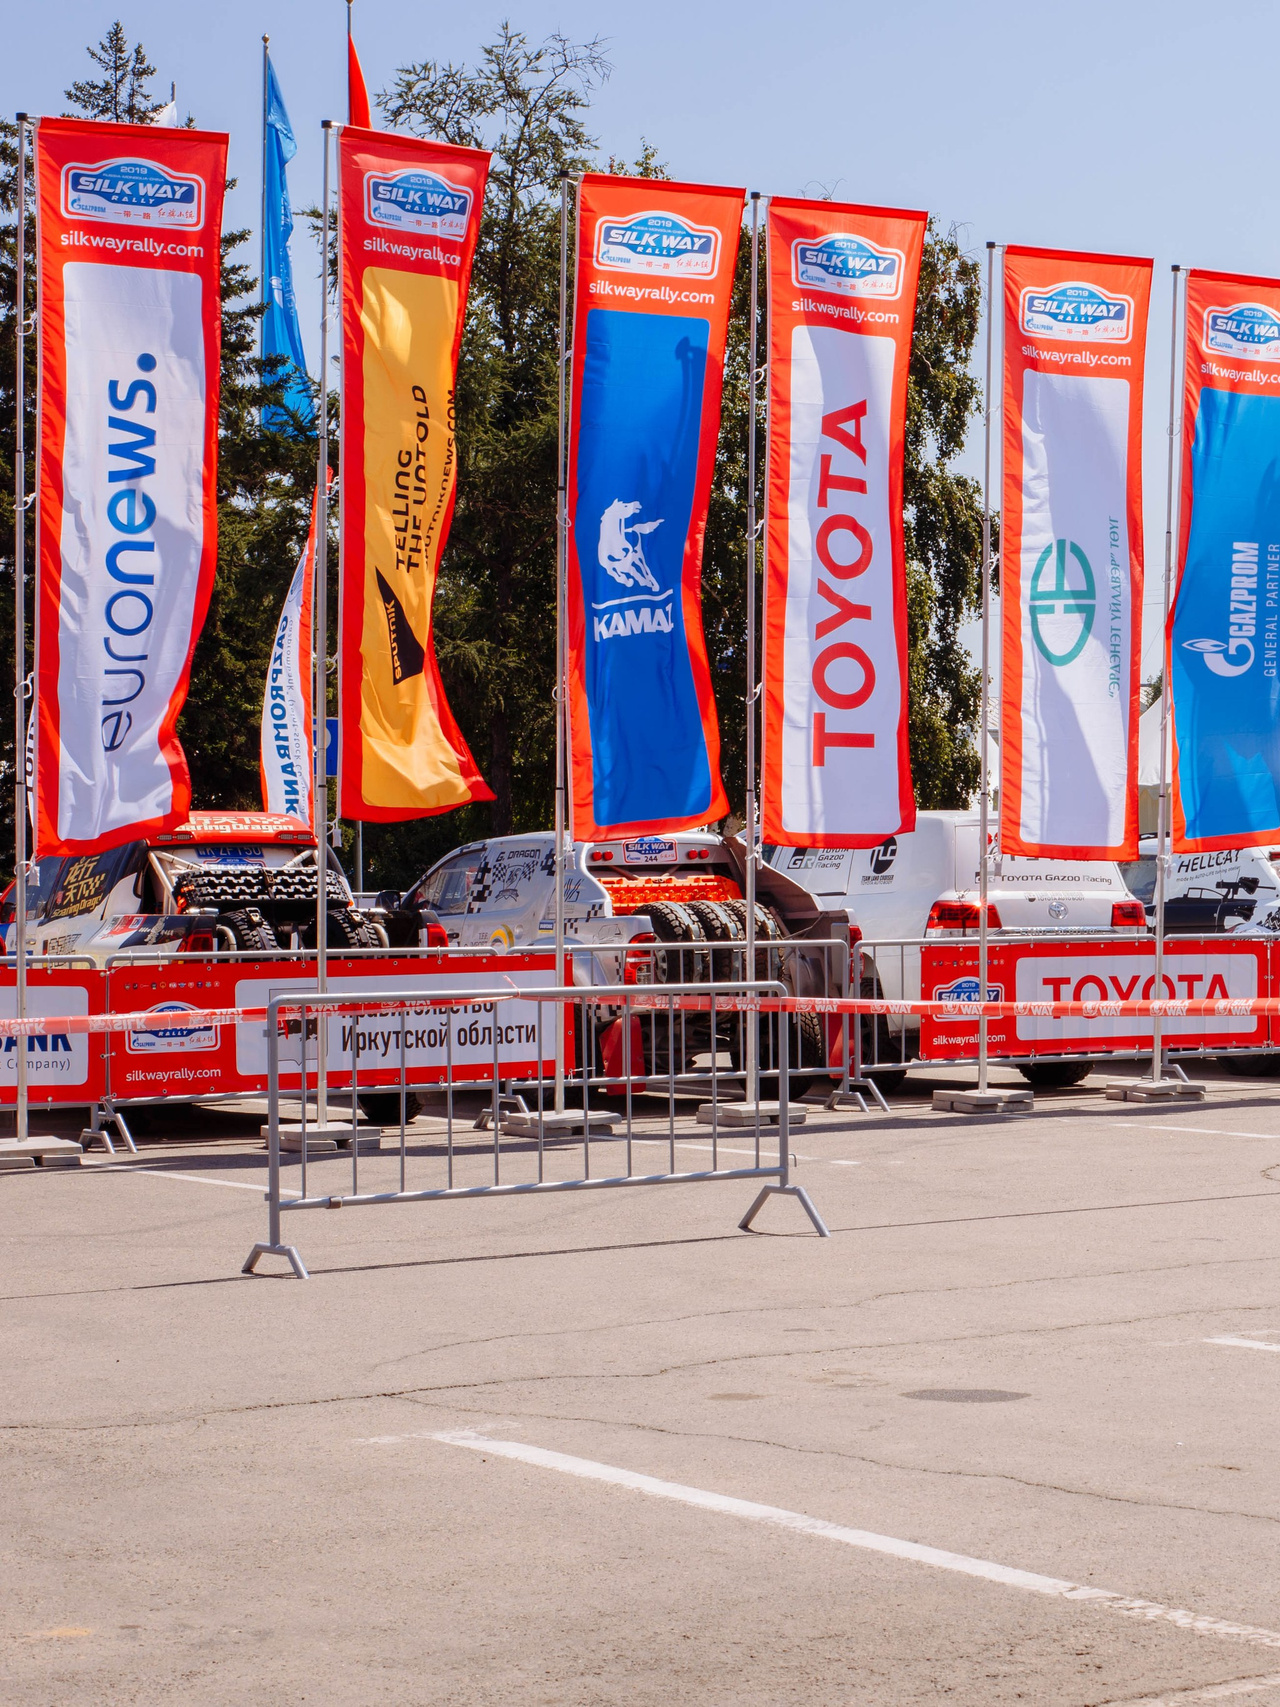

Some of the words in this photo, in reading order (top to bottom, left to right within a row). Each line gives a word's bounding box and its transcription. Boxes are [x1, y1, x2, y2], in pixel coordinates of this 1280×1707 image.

[120, 166, 147, 174] 2019
[410, 176, 433, 185] 2019
[77, 176, 135, 195] SILK
[138, 183, 189, 199] WAY
[377, 186, 423, 204] SILK
[427, 192, 465, 210] WAY
[112, 195, 155, 204] RALLY
[406, 205, 441, 214] RALLY
[648, 219, 672, 227] 2019
[61, 231, 204, 257] silkwayrally.com
[608, 229, 660, 247] SILK
[662, 236, 707, 250] WAY
[637, 247, 676, 255] RALLY
[805, 250, 846, 268] SILK
[848, 256, 892, 272] WAY
[828, 268, 861, 276] RALLY
[589, 281, 715, 304] silkwayrally.com
[792, 298, 899, 323] silkwayrally.com
[1032, 299, 1077, 314] SILK
[1080, 304, 1121, 317] WAY
[1215, 318, 1252, 334] SILK
[1022, 345, 1131, 366] silkwayrally.com
[412, 384, 428, 506] UNTOLD
[394, 449, 413, 571] TELLING
[101, 352, 157, 753] euronews.
[407, 514, 421, 573] THE
[811, 399, 876, 767] TOYOTA
[1266, 543, 1280, 607] PARTNER
[1229, 541, 1259, 637] GAZPROM
[594, 602, 673, 642] KAMAZ
[386, 599, 402, 682] SPUTNIK
[1264, 614, 1277, 677] GENERAL
[174, 824, 231, 833] oaring
[232, 824, 293, 832] Dragon
[507, 849, 541, 859] DRAGON
[787, 856, 815, 869] GR
[1178, 850, 1242, 873] HELLCAT
[1083, 876, 1112, 885] Racing
[941, 992, 969, 1001] SILK
[1042, 974, 1231, 1019] TOYOTA
[7, 1058, 70, 1071] Cmpany)
[126, 1068, 220, 1082] silkwayrally.com
